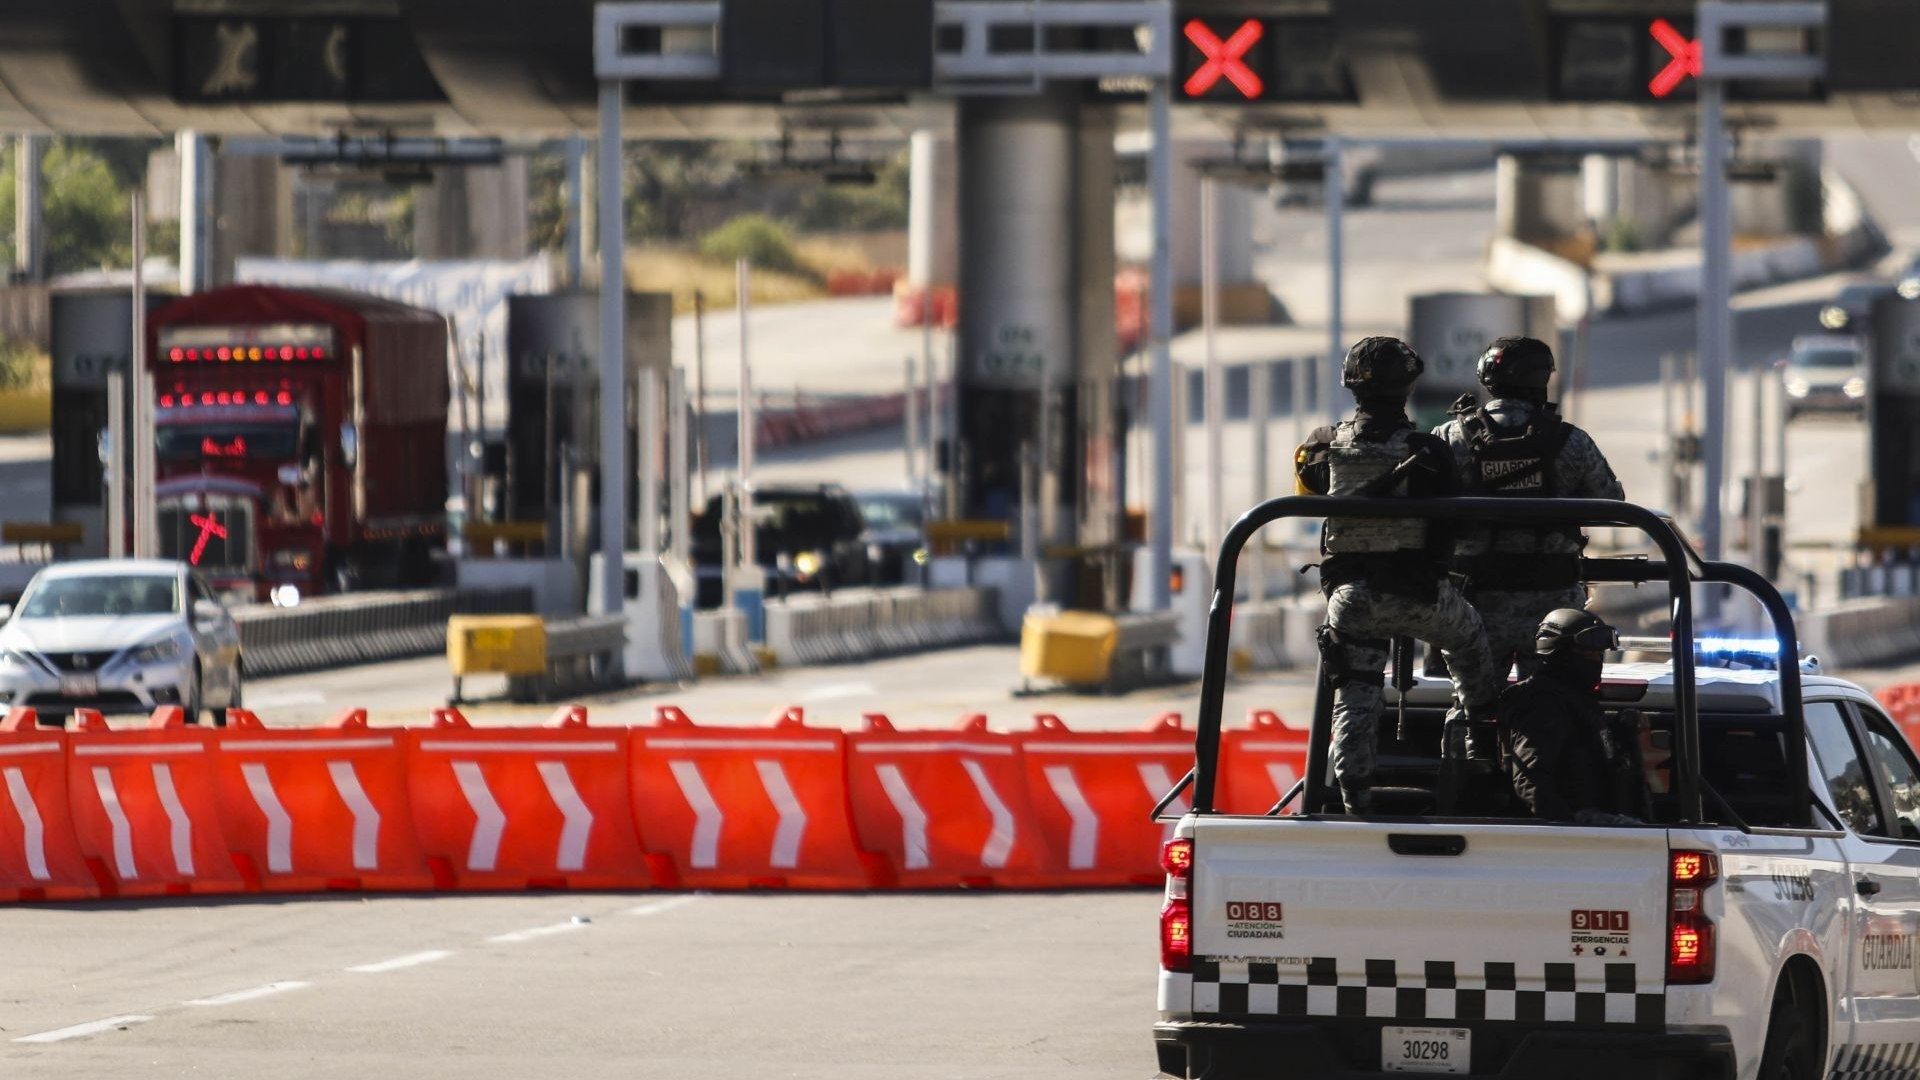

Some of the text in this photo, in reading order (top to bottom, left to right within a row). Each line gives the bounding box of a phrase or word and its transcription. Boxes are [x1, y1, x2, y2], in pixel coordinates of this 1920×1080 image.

[1484, 459, 1538, 477] GUARD
[1228, 903, 1279, 920] 088
[1574, 912, 1624, 929] 911
[1227, 930, 1284, 939] CIUDADANA
[1571, 936, 1629, 944] EMERGENCIAS
[1863, 934, 1912, 970] GUARDIA
[1403, 1040, 1449, 1060] 30298
